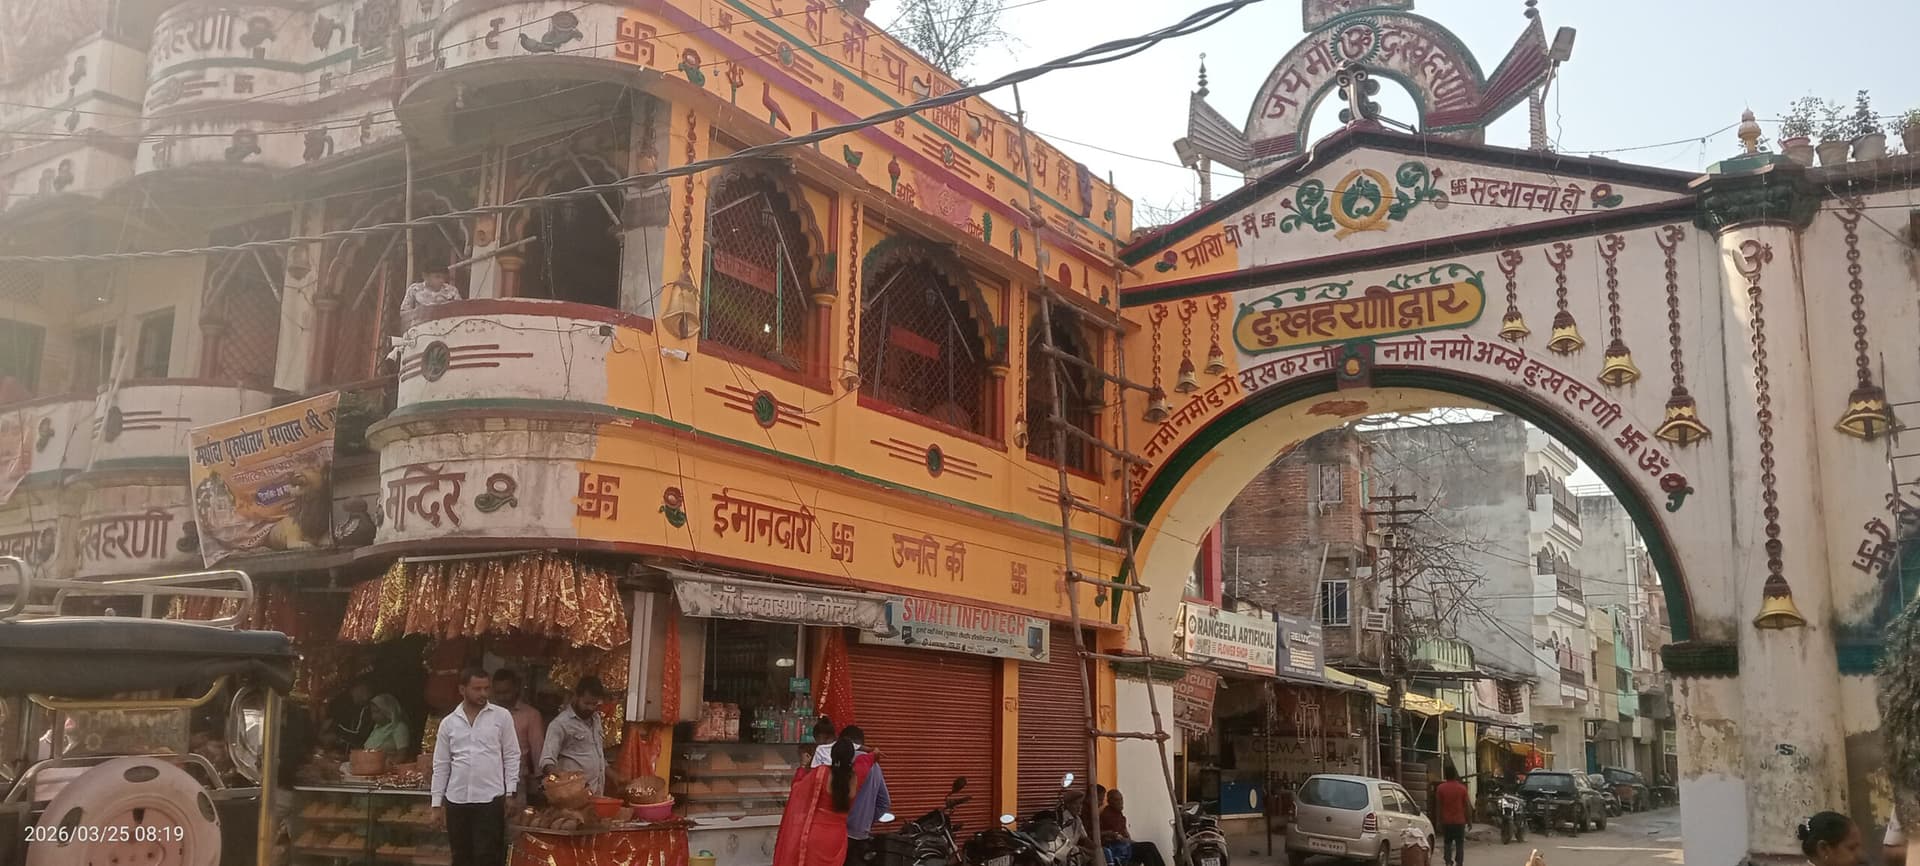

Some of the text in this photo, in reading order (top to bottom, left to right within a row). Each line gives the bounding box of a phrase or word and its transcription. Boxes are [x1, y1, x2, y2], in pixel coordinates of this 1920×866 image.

[1560, 183, 1585, 215] हो
[1376, 335, 1426, 362] नमो
[1430, 334, 1474, 361] नमो
[305, 408, 329, 435] श्री
[1143, 420, 1179, 458] नमो
[1171, 394, 1209, 427] नमो
[712, 487, 966, 581] ईमानदारी उन्नति की
[903, 597, 952, 627] SWATI
[956, 604, 1027, 637] INFOTECH
[1238, 626, 1275, 650] ARTIFICIAL
